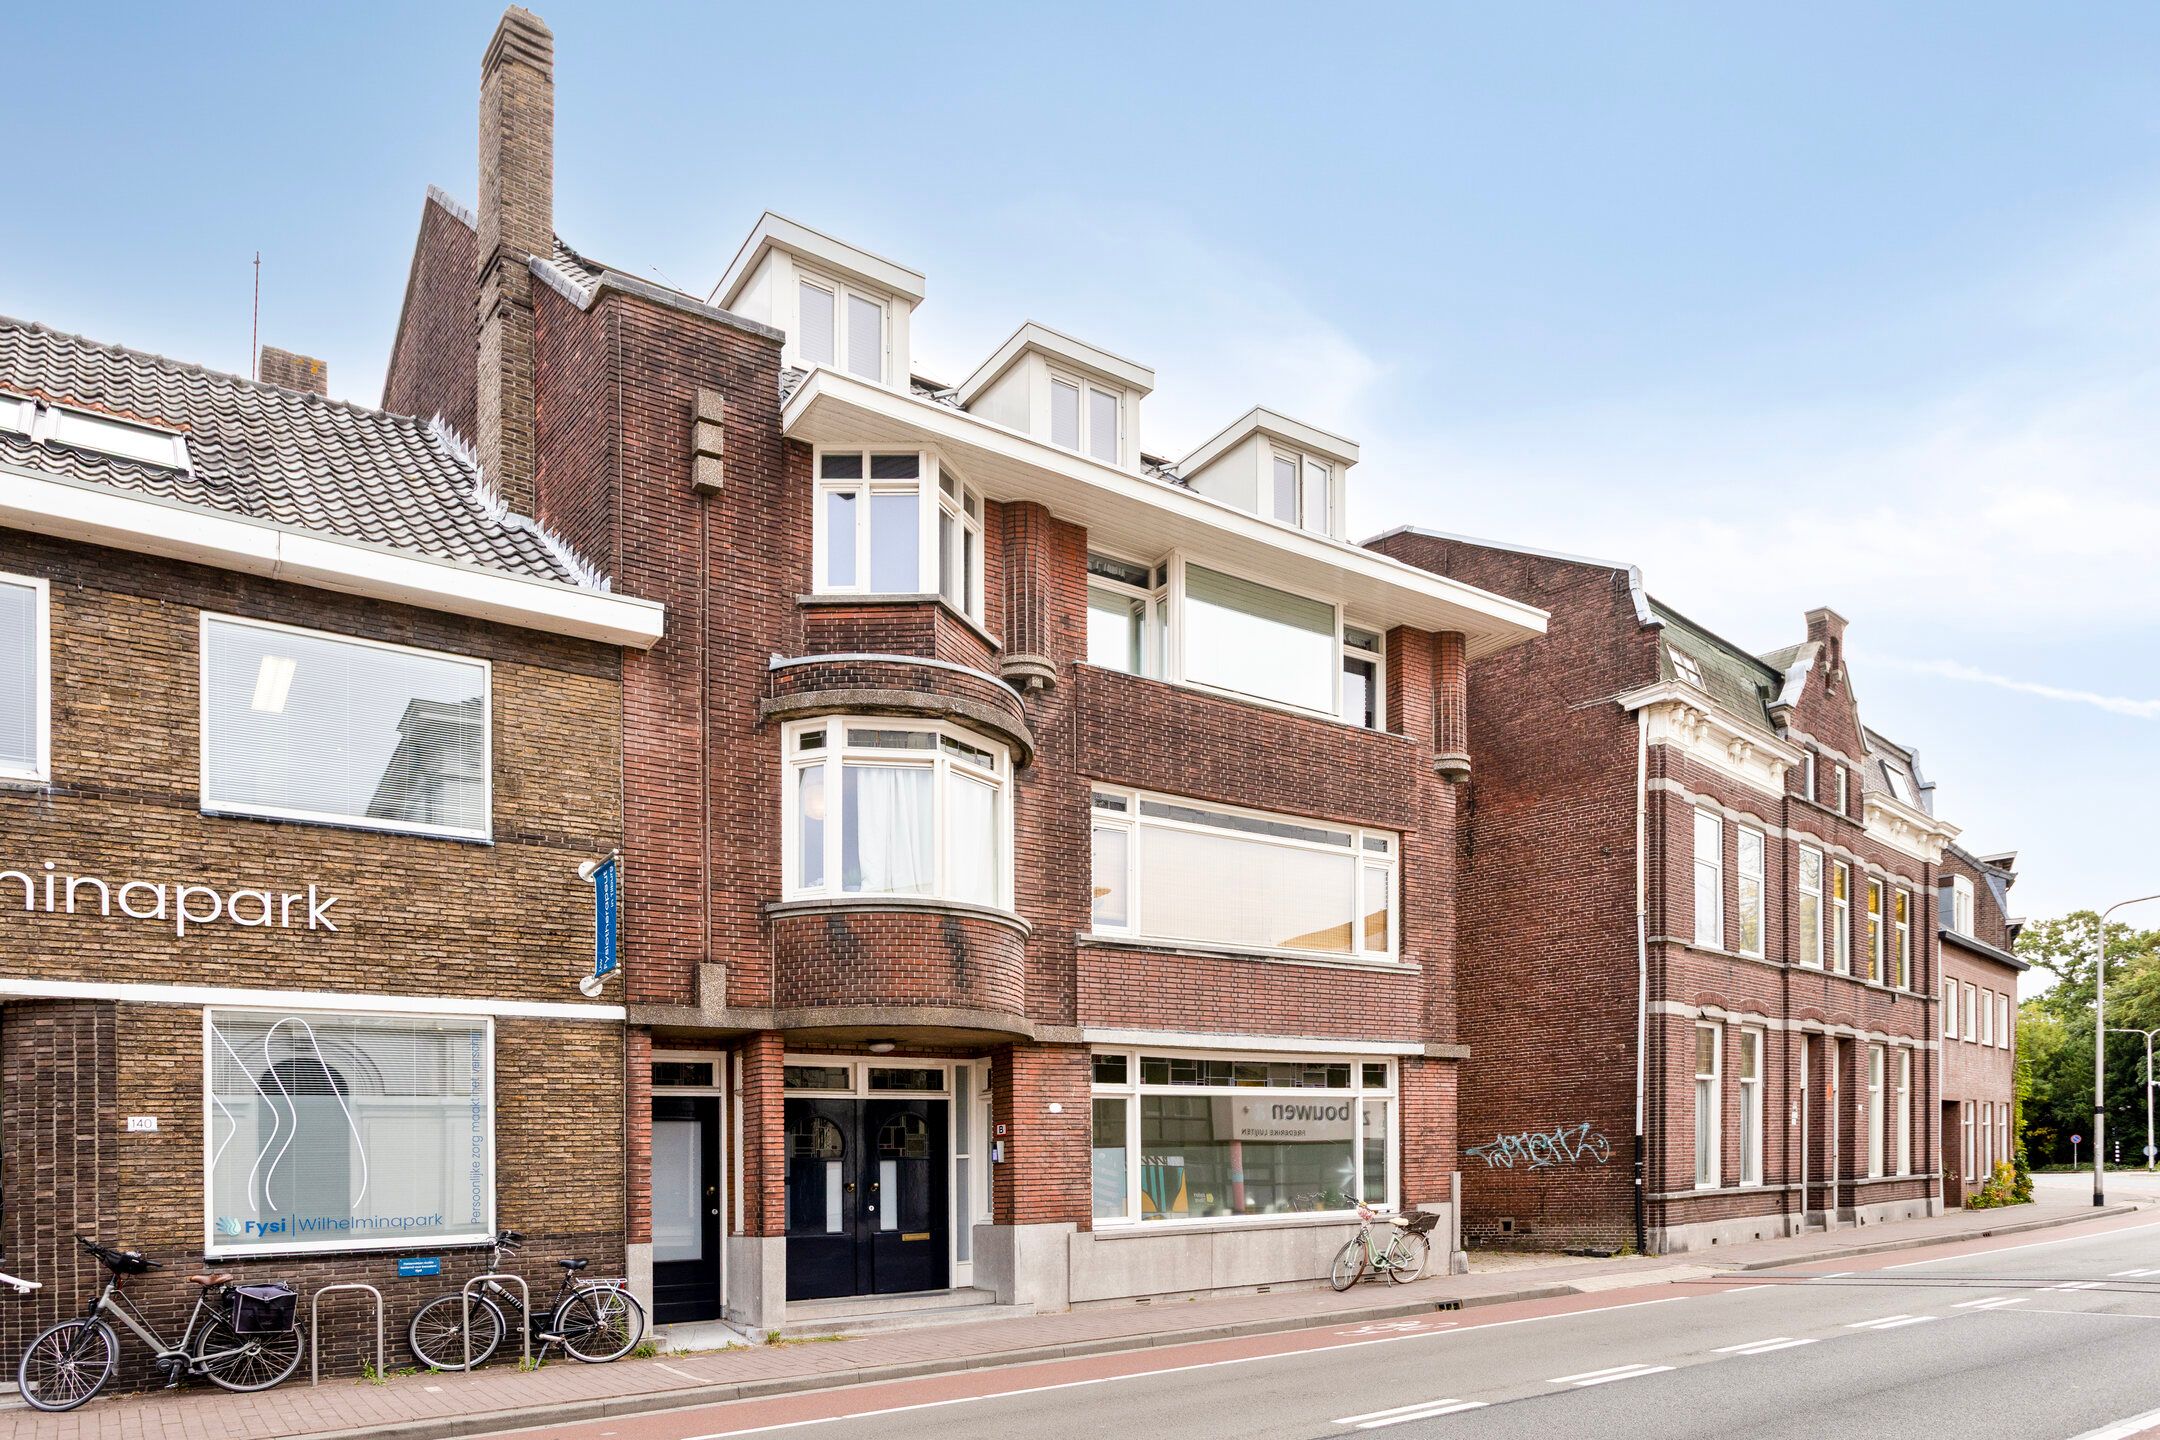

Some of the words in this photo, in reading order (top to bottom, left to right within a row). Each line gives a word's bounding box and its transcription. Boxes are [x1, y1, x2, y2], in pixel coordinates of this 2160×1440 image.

[602, 870, 610, 970] Fysiotherapeut
[132, 1118, 152, 1128] 140
[470, 1098, 480, 1132] maakt
[471, 1136, 483, 1158] zorg
[470, 1161, 483, 1224] Persoonlijke
[245, 1219, 286, 1237] Fysi
[299, 1213, 443, 1232] Wilhelminapark
